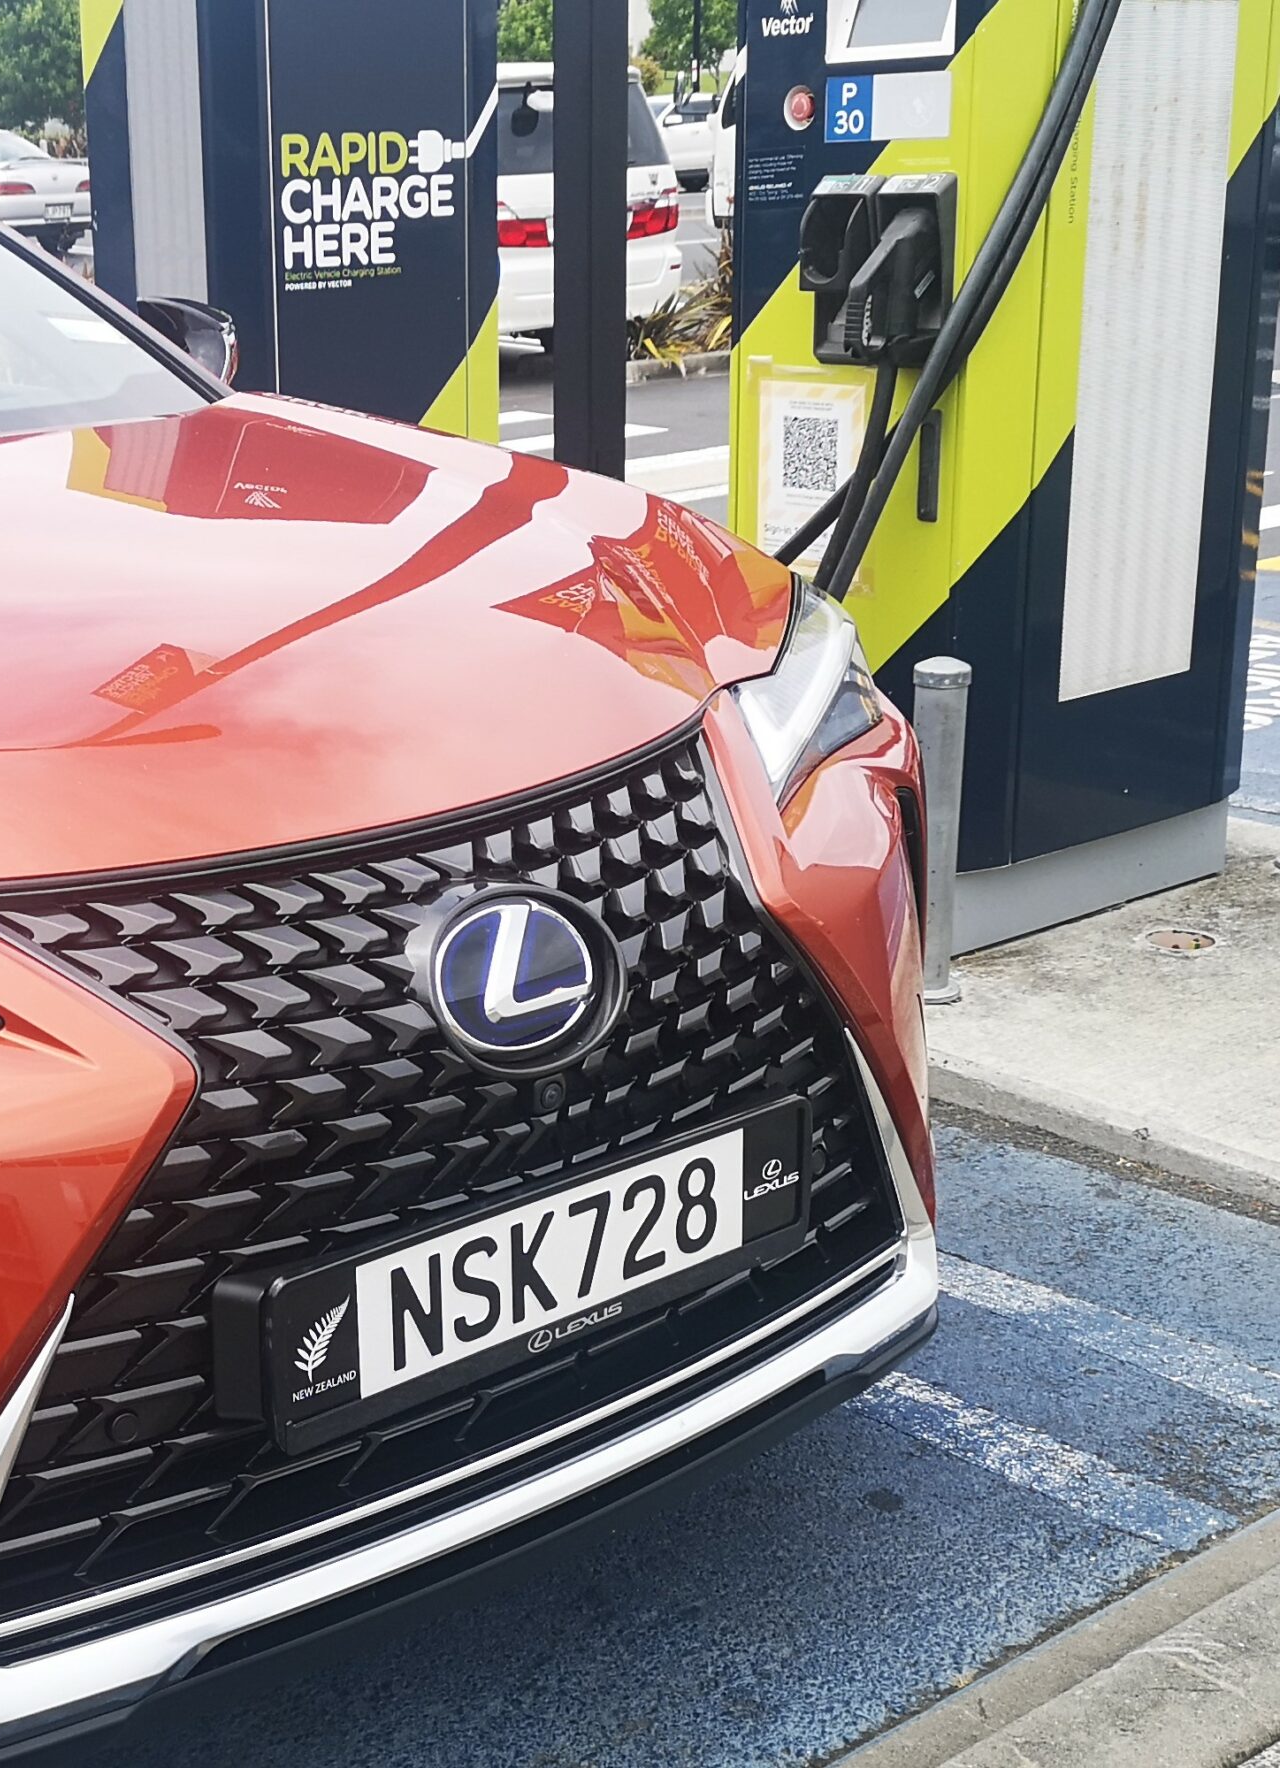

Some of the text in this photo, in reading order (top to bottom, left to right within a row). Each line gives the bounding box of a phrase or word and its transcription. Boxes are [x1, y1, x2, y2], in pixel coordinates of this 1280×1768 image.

[761, 13, 814, 38] Vector
[841, 82, 858, 106] P
[833, 109, 865, 135] 30
[281, 131, 409, 178] RAPID
[281, 174, 455, 224] CHARGE
[1068, 176, 1079, 225] Station
[283, 221, 397, 270] HERE
[284, 279, 353, 291] POWERED BY VECTOR
[285, 266, 402, 281] Electric Vehicle Charging Station
[743, 1170, 800, 1201] LEXUS
[390, 1157, 718, 1372] NSK728
[555, 1301, 623, 1339] LEXUS
[292, 1369, 357, 1403] NEW ZEALAND
